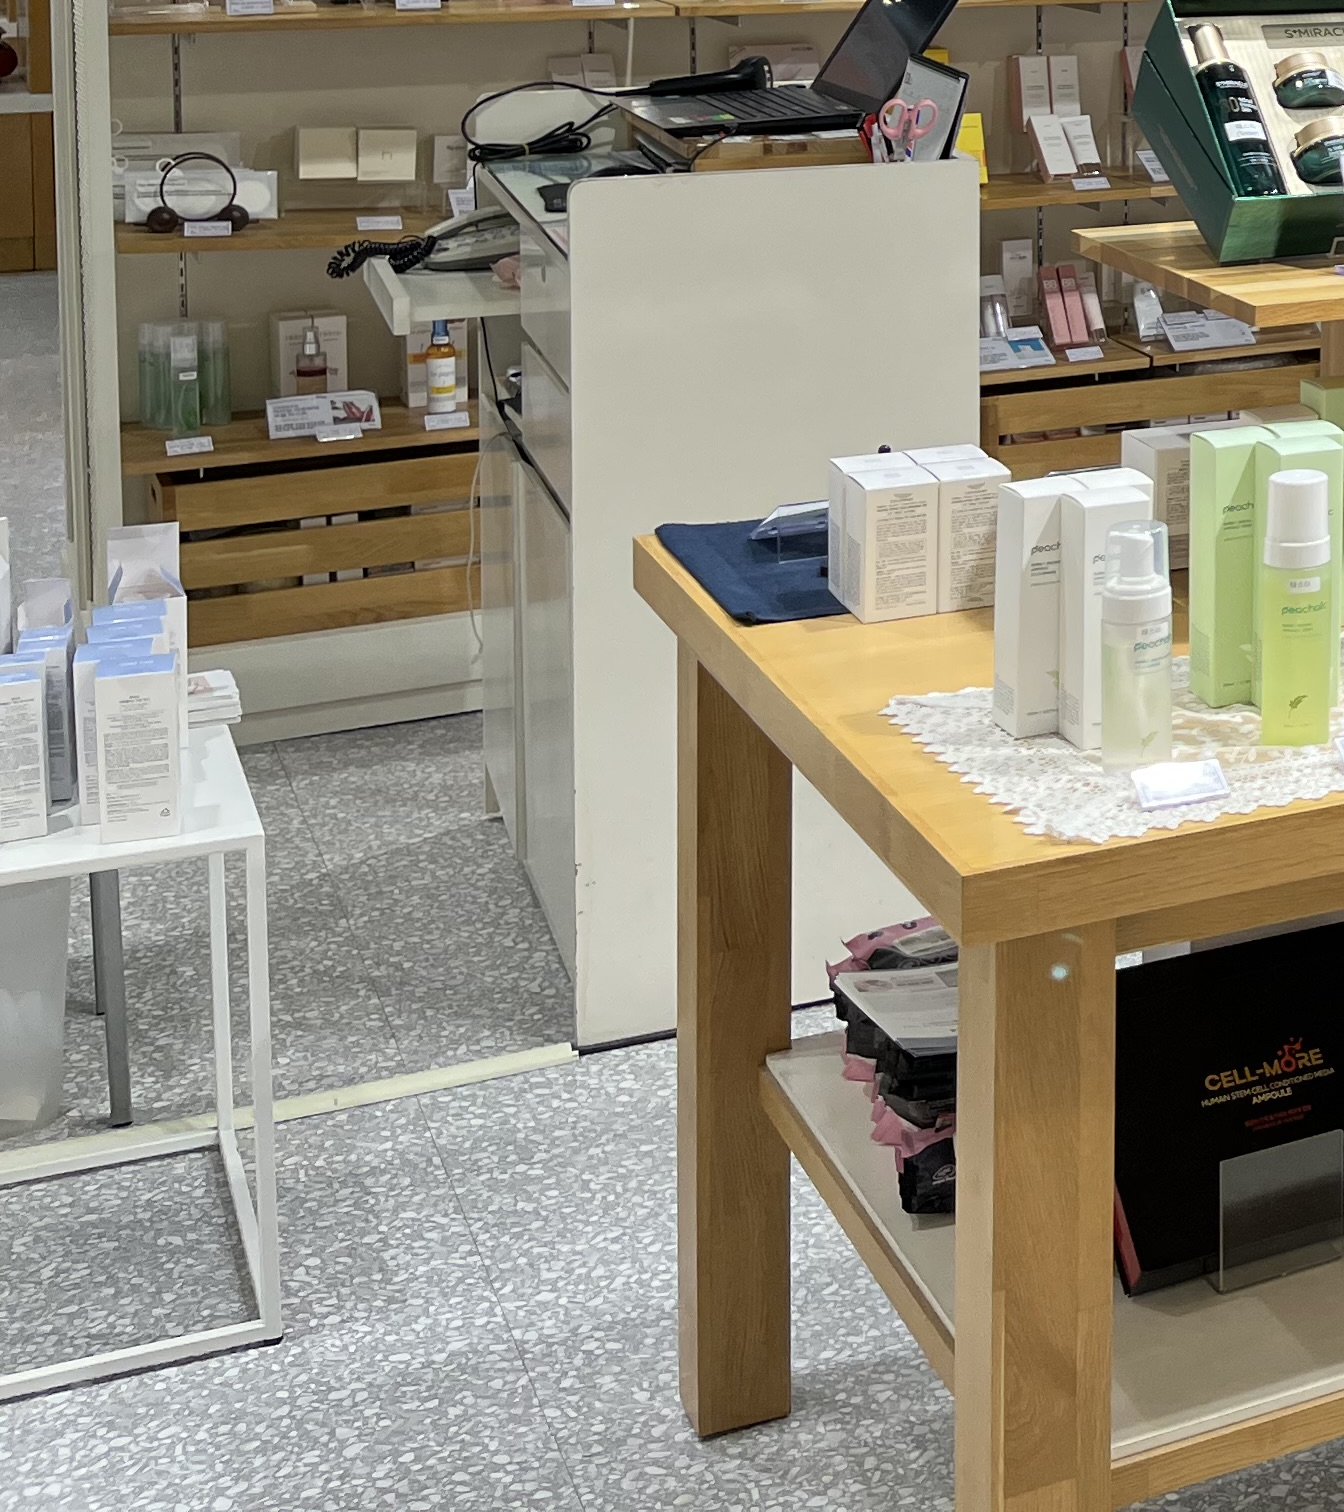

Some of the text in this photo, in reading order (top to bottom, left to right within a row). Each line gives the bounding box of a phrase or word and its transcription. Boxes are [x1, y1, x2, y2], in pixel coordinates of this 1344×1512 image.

[1281, 601, 1327, 616] peacholic
[1204, 1047, 1324, 1090] CELL-MORE
[1201, 1094, 1231, 1107] HUMAN
[1230, 1088, 1251, 1100] STEM
[1251, 1085, 1270, 1094] CELL
[1314, 1067, 1335, 1078] MEDIA
[1252, 1087, 1293, 1104] AMPOULE
